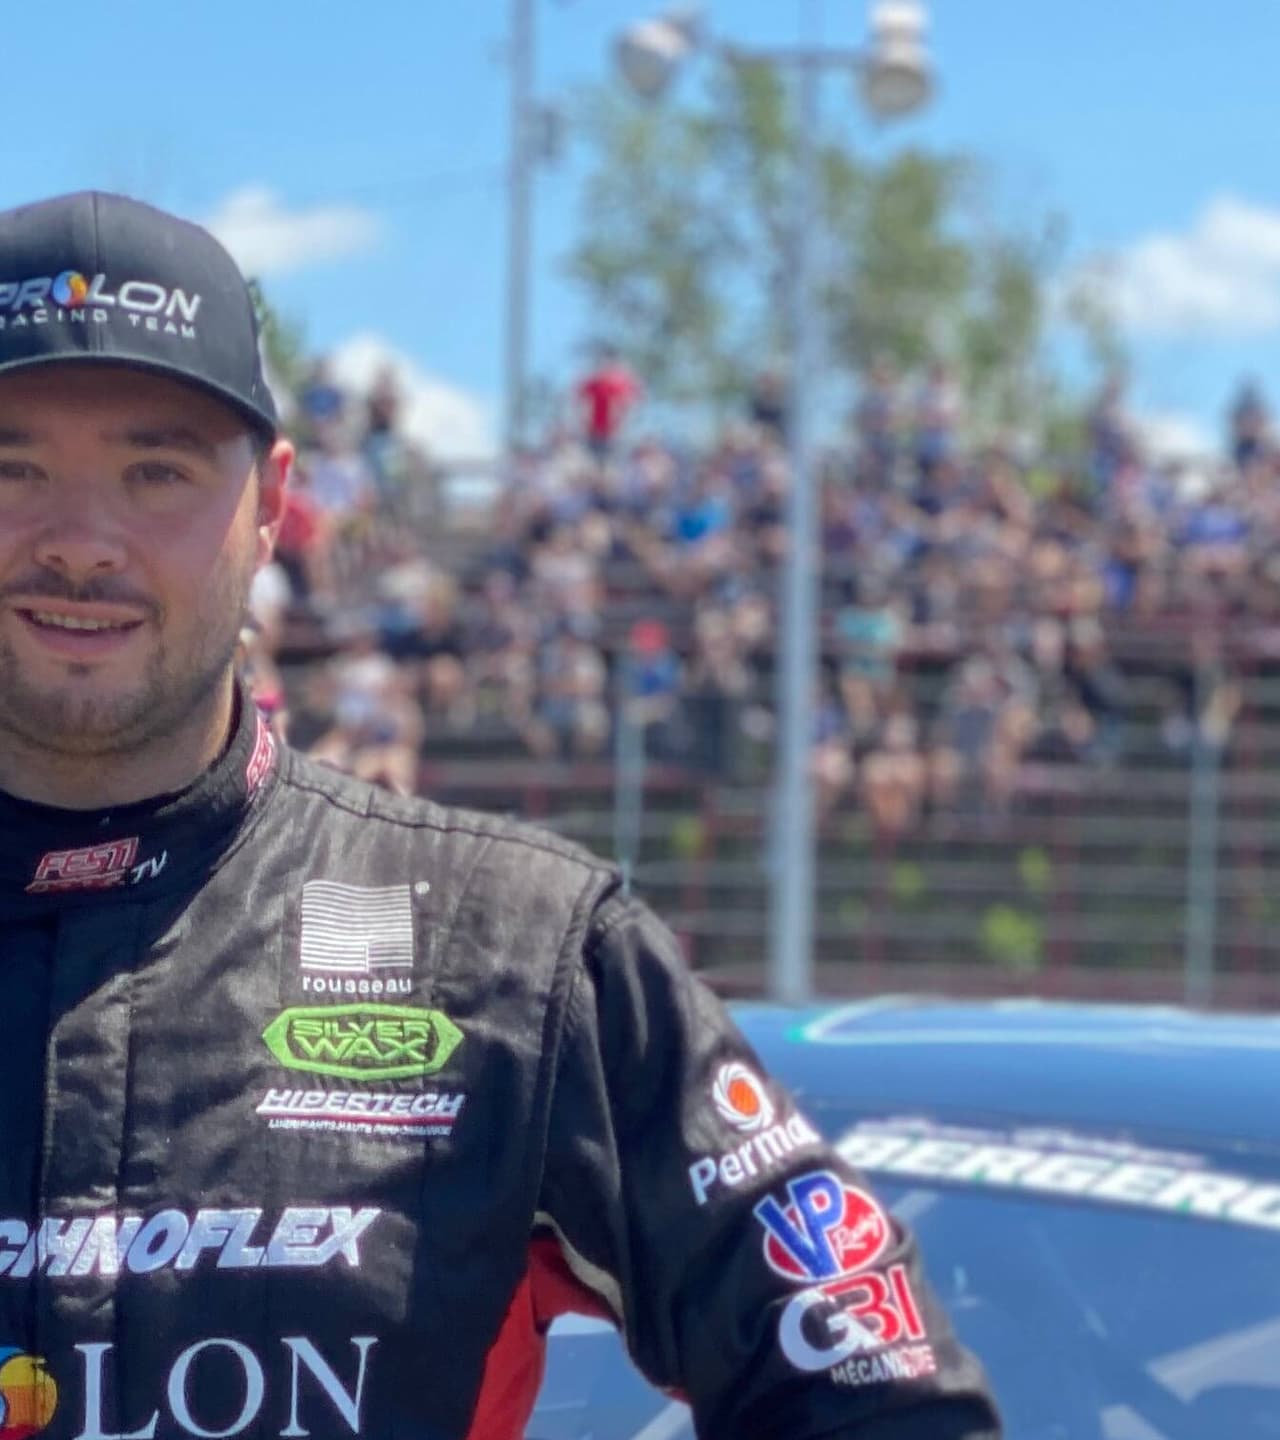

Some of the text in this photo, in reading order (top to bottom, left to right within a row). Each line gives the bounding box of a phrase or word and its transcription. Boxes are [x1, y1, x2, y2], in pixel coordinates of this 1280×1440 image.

[128, 313, 197, 338] TEAM
[131, 849, 167, 884] TV
[302, 975, 413, 994] rousseau
[292, 1018, 431, 1039] SILVER
[293, 1036, 427, 1061] WAX
[260, 1087, 466, 1116] HIPERTECH
[753, 1170, 846, 1281] VP
